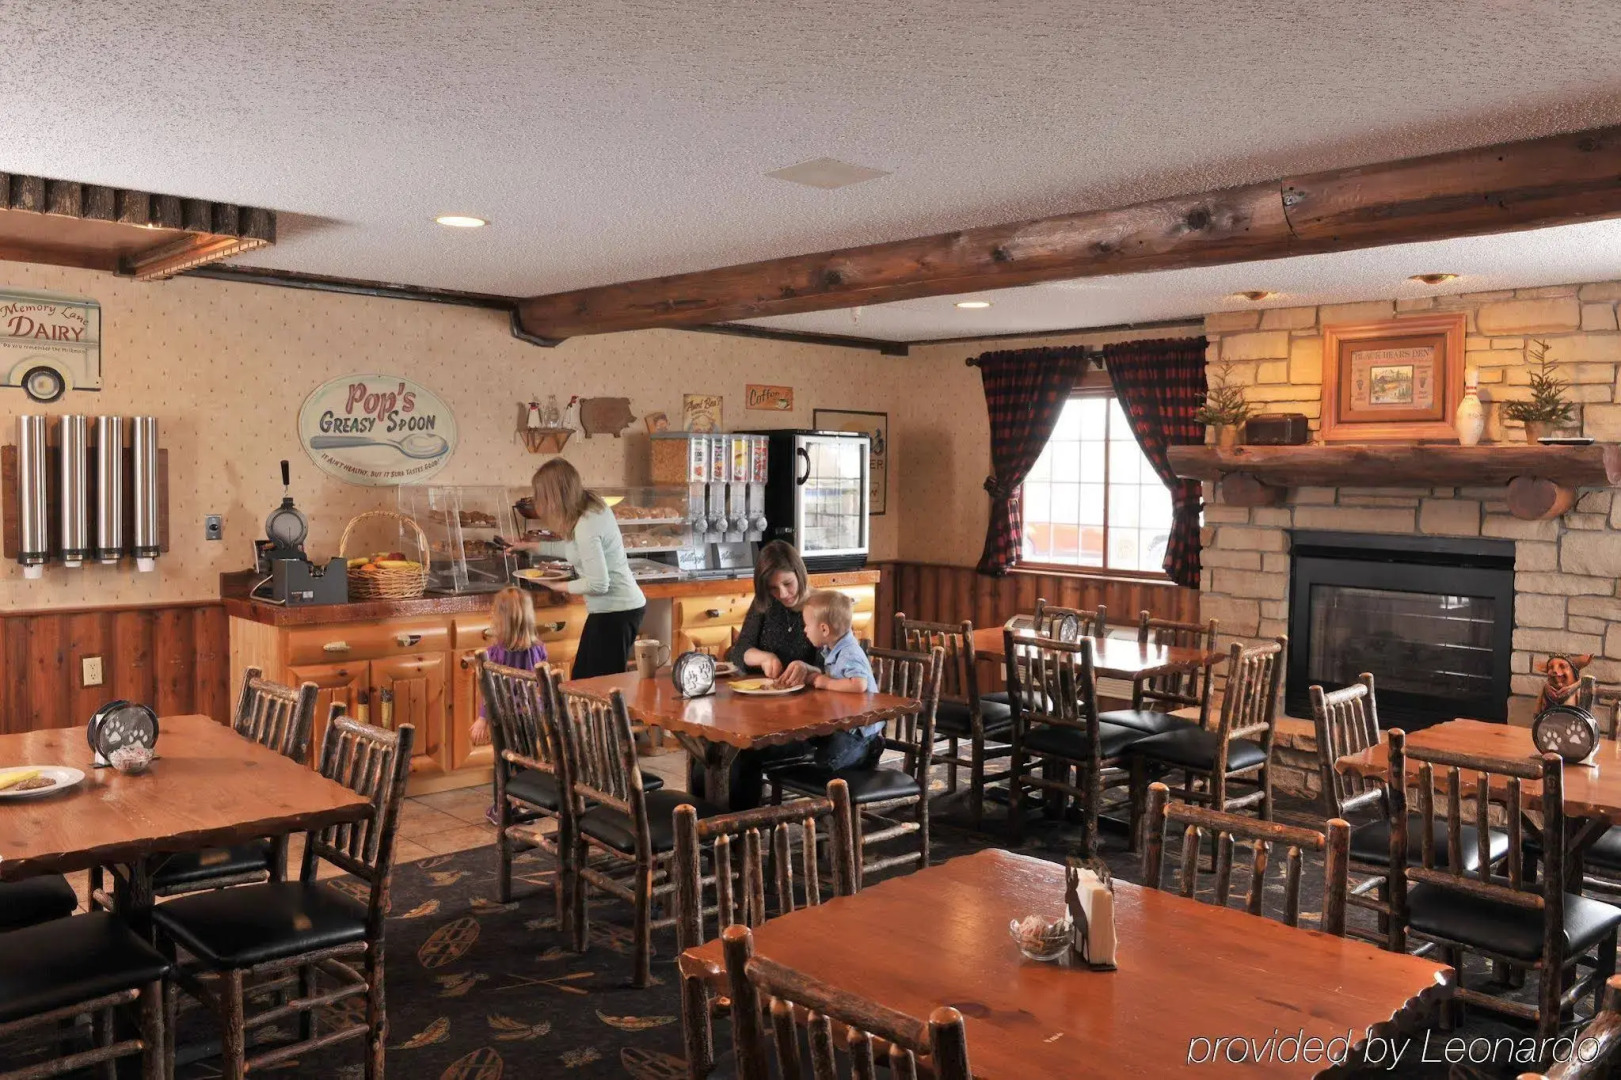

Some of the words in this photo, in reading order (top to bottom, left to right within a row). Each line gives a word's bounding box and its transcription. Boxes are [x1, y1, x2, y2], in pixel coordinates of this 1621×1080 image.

[1, 302, 56, 317] Memory
[61, 306, 89, 326] Lane
[8, 315, 84, 342] DAIRY
[345, 382, 417, 422] Pop's
[319, 410, 376, 433] GREASY
[406, 465, 424, 475] TASTES
